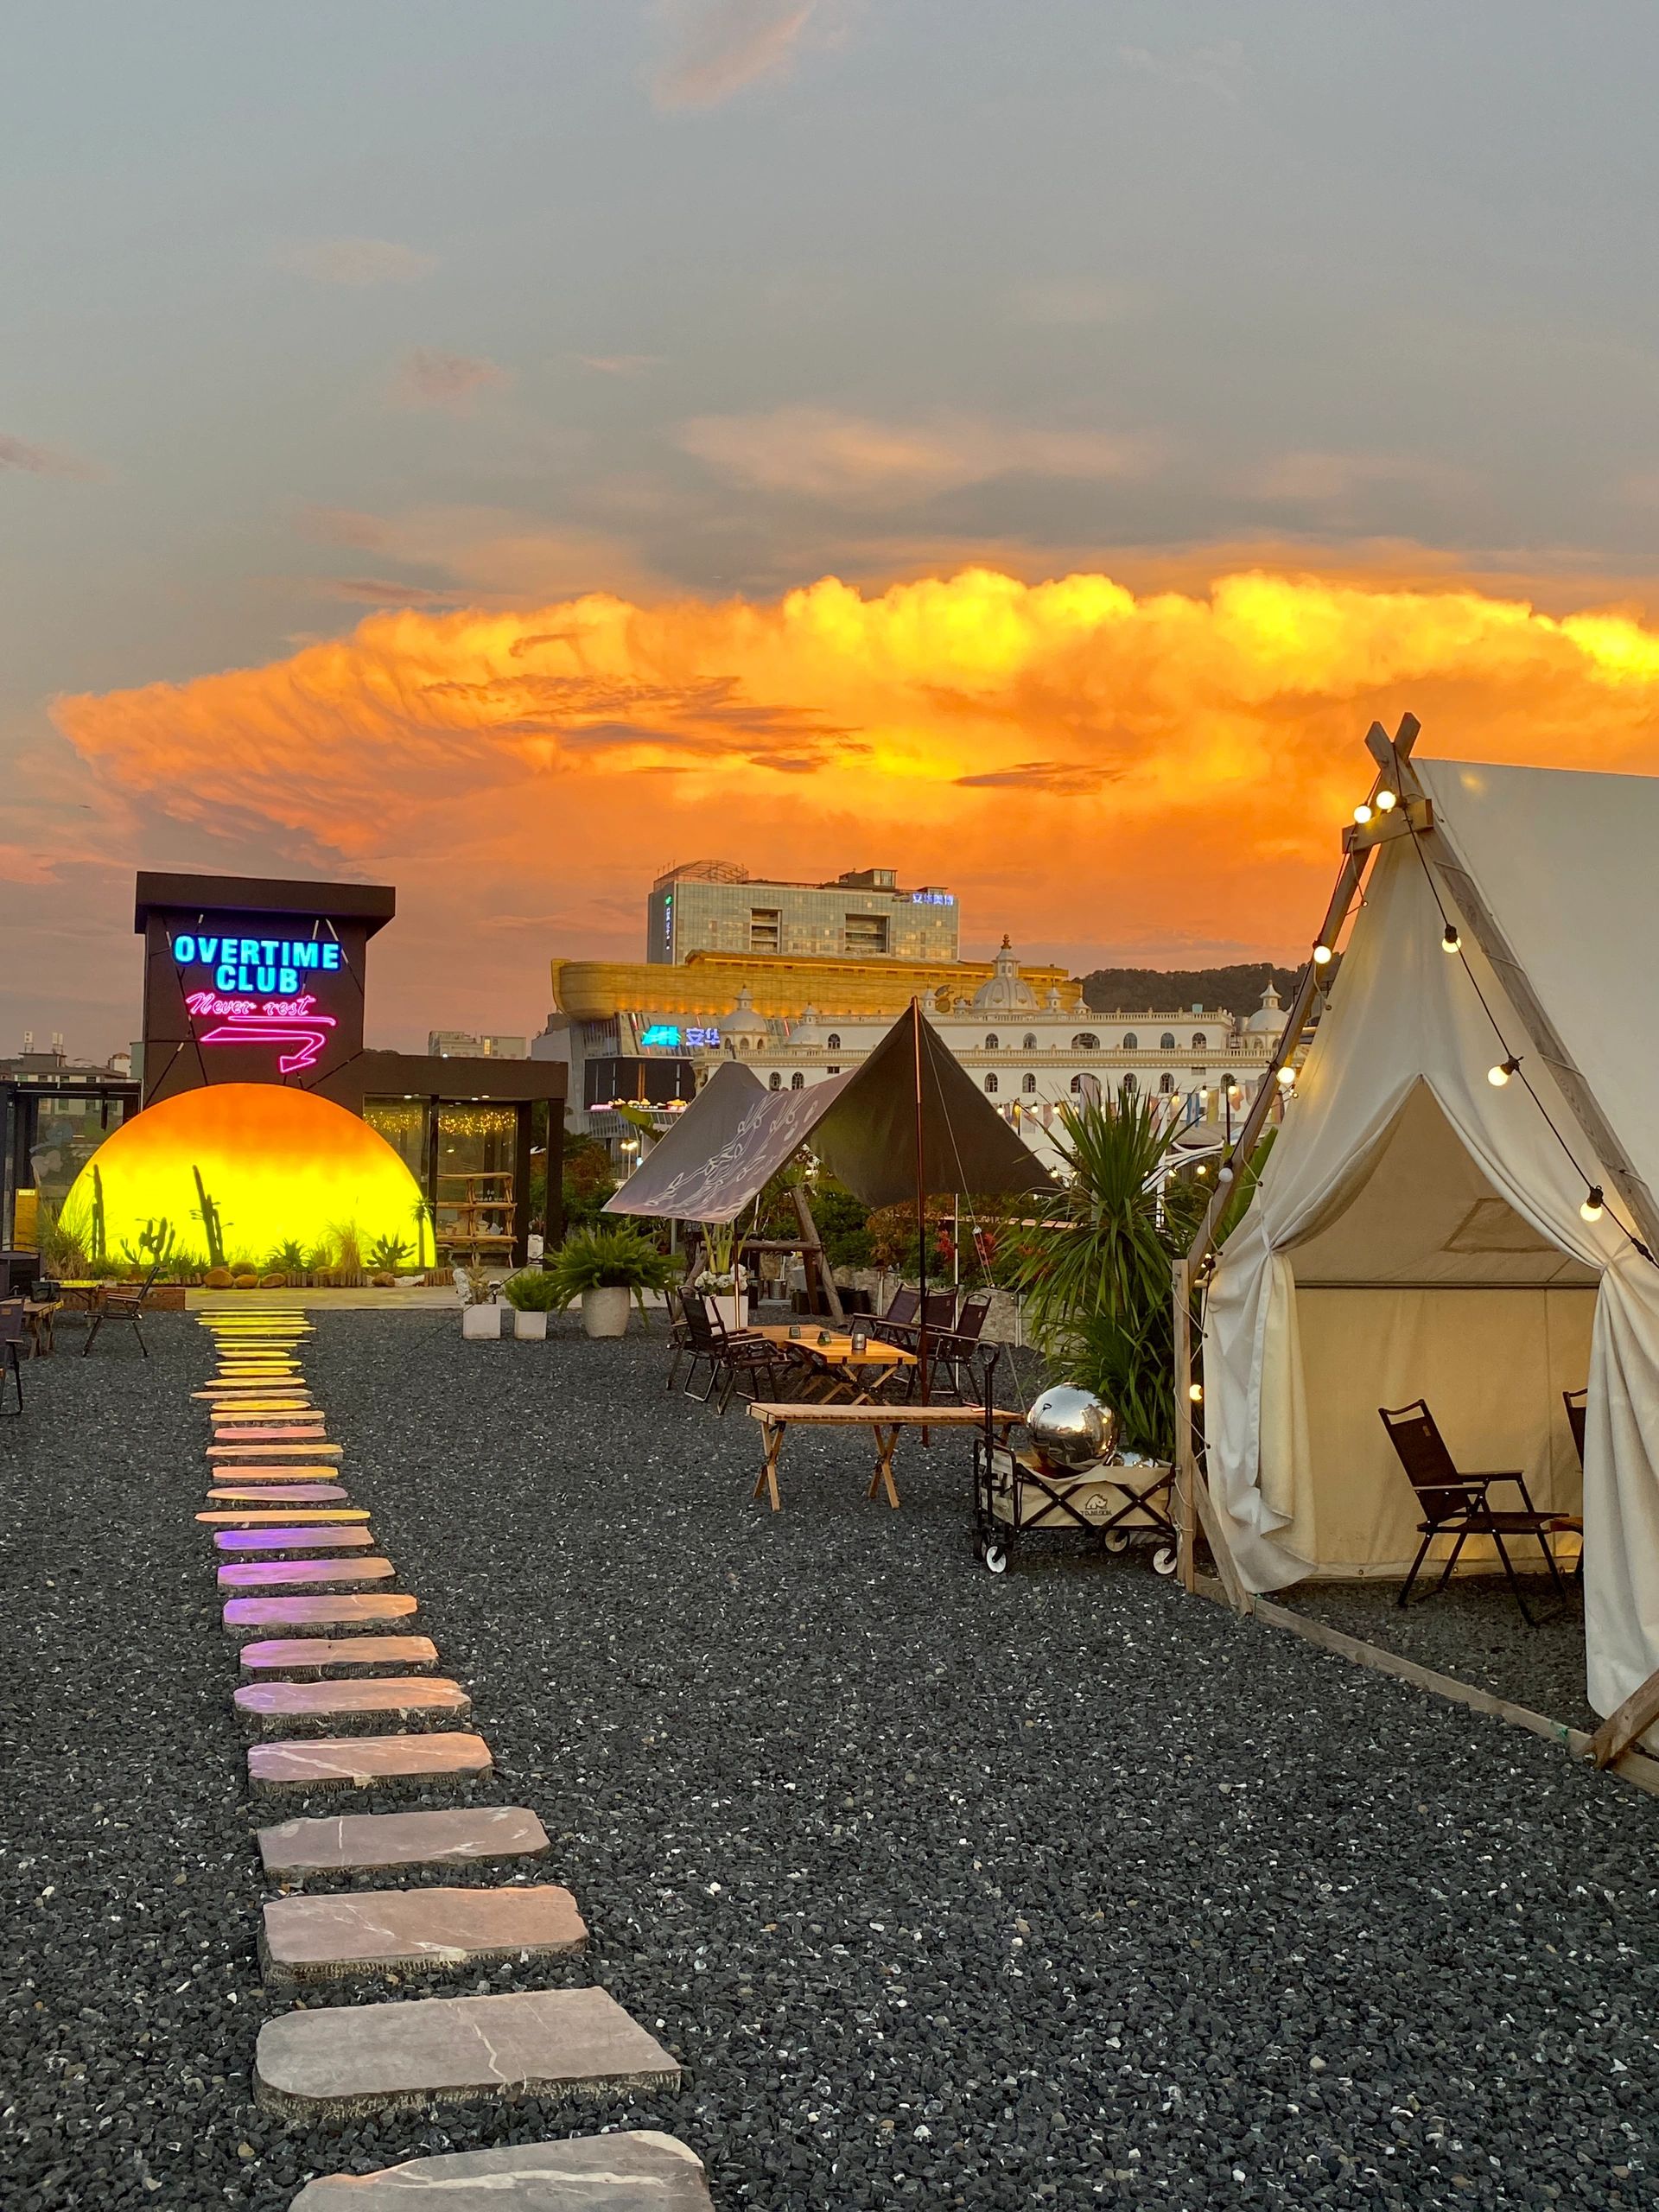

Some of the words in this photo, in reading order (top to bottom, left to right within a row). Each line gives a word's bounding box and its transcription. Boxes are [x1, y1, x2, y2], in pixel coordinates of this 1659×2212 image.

[175, 935, 339, 969] OVERTIME
[217, 965, 298, 993] CLUB
[185, 993, 257, 1015] Never
[263, 995, 316, 1015] rest
